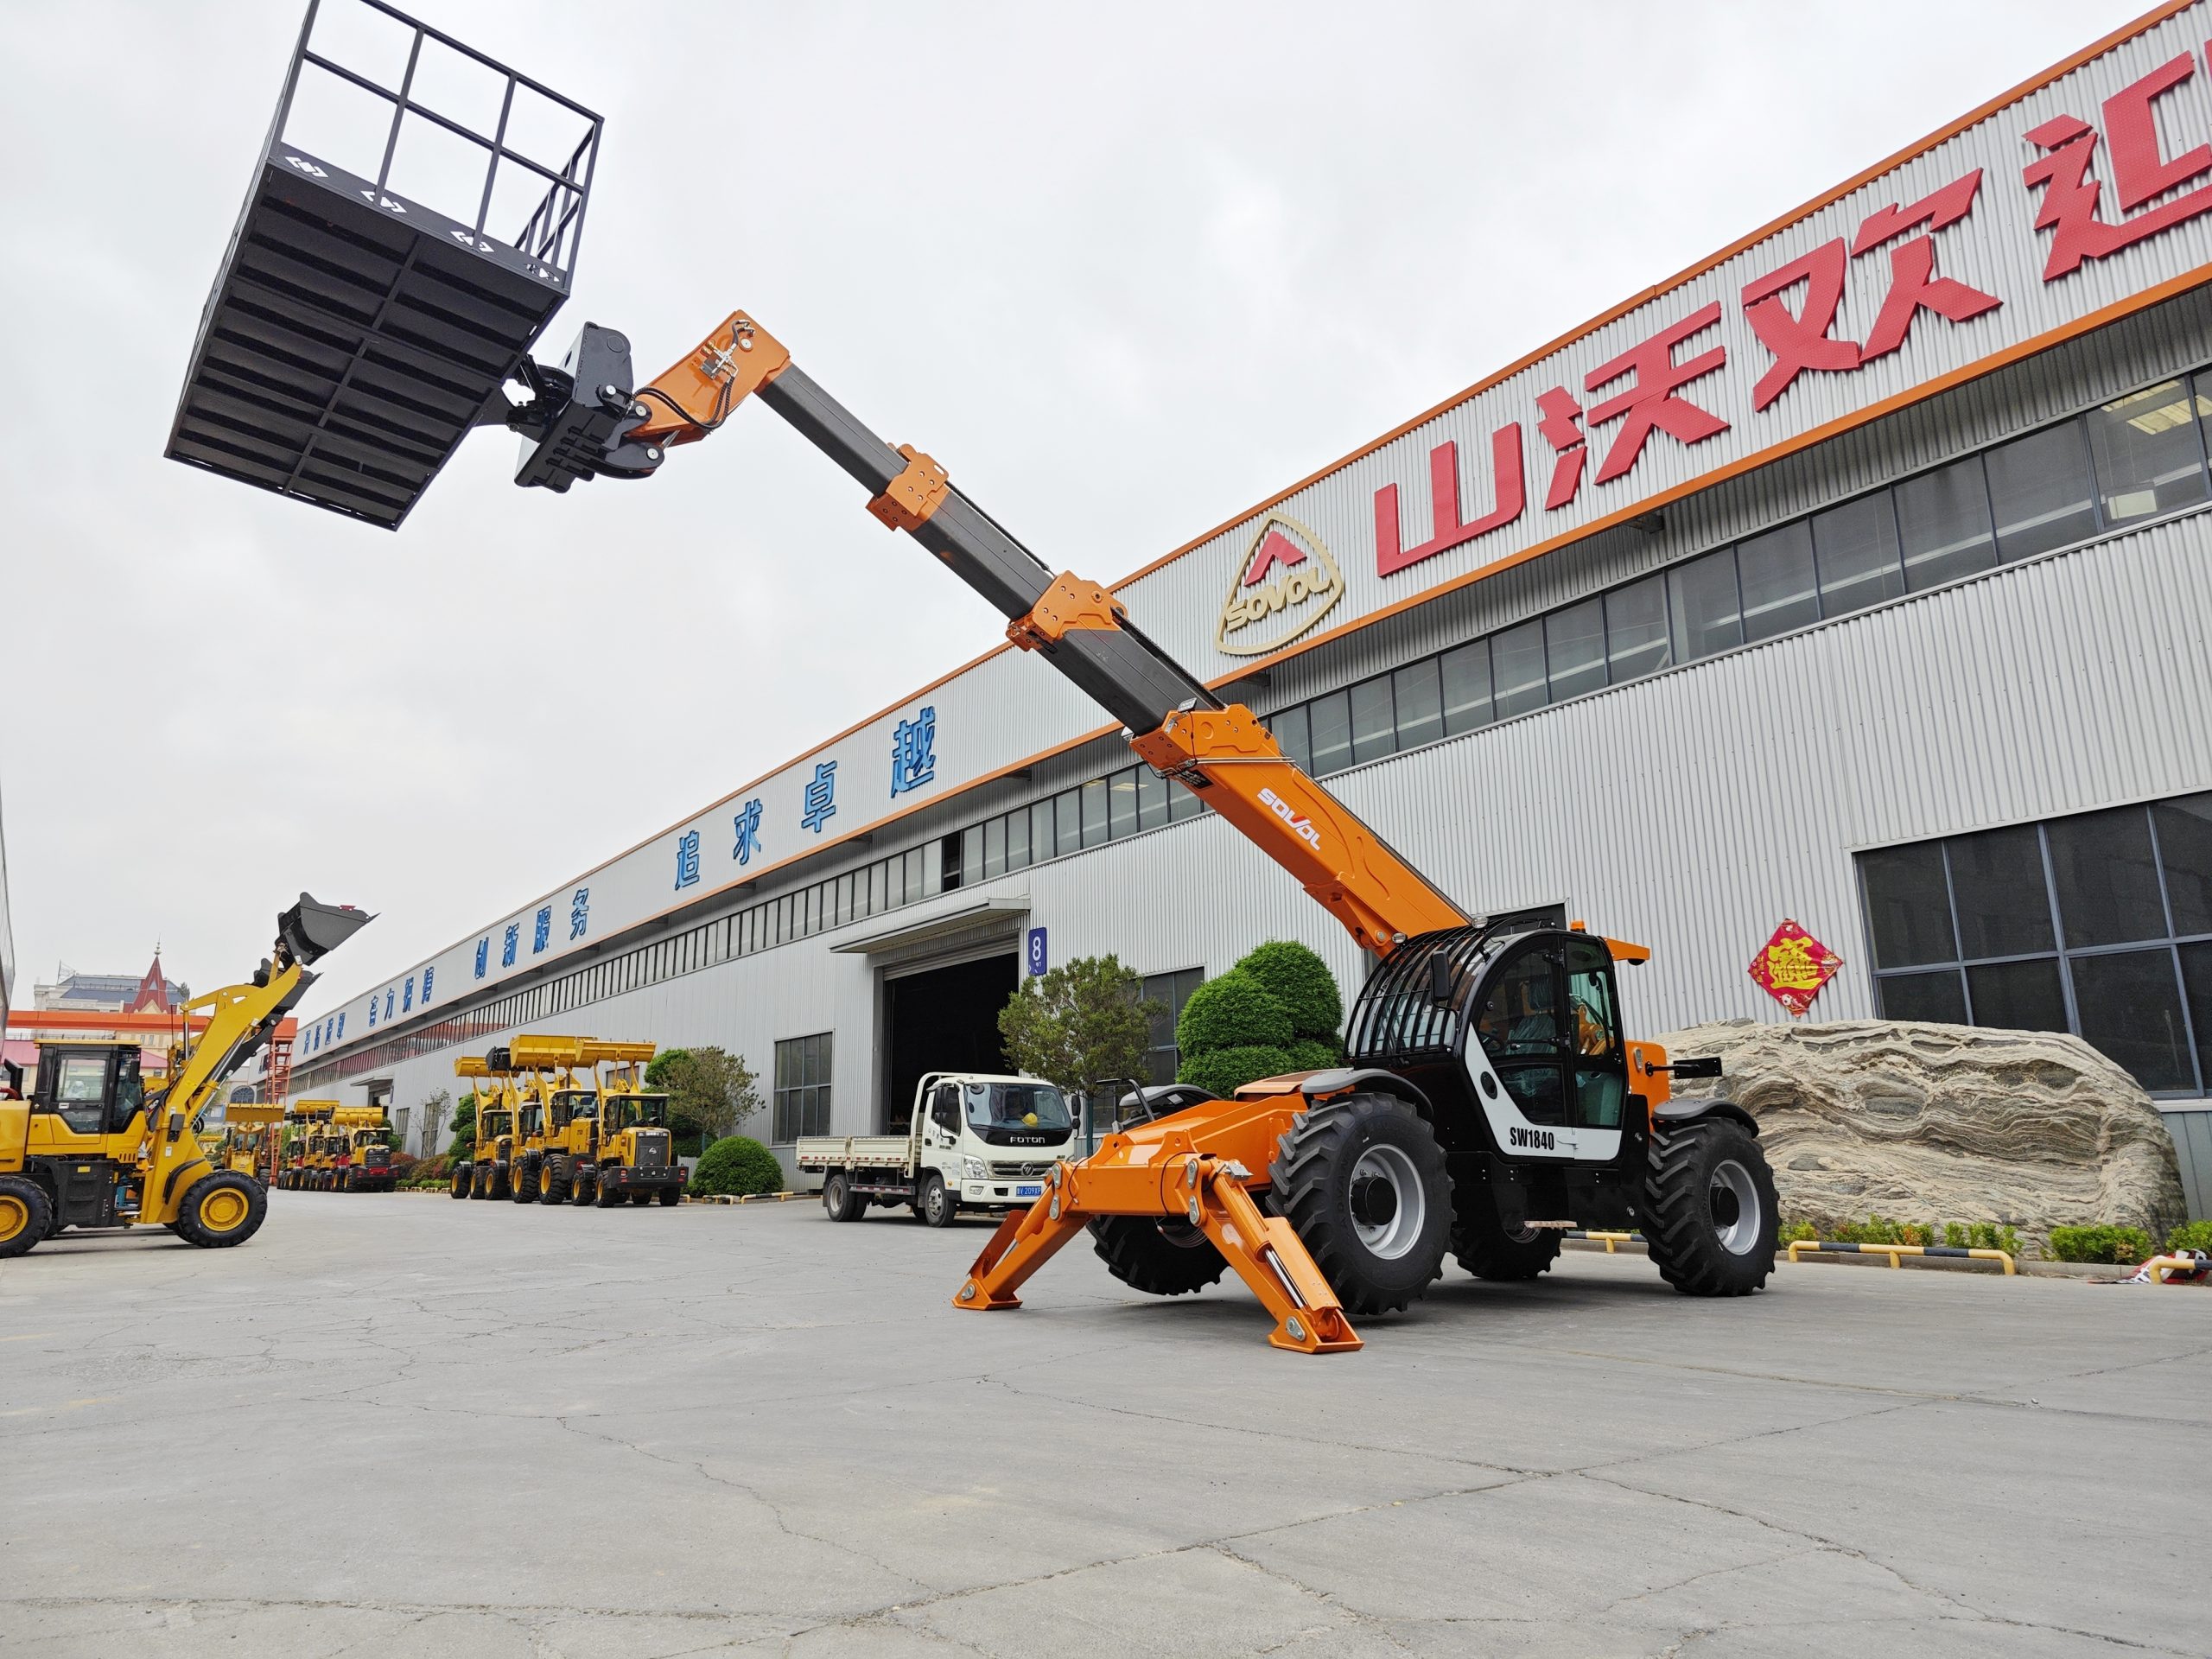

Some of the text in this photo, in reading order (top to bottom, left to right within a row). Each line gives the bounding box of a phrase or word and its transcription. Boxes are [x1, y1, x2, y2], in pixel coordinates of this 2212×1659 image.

[1225, 567, 1333, 632] SOVOL
[474, 888, 589, 979] 创新服务
[675, 706, 936, 891] 追求卓越
[1257, 787, 1320, 851] SOVOL
[1033, 936, 1042, 962] 8
[1510, 1127, 1554, 1151] SW1840
